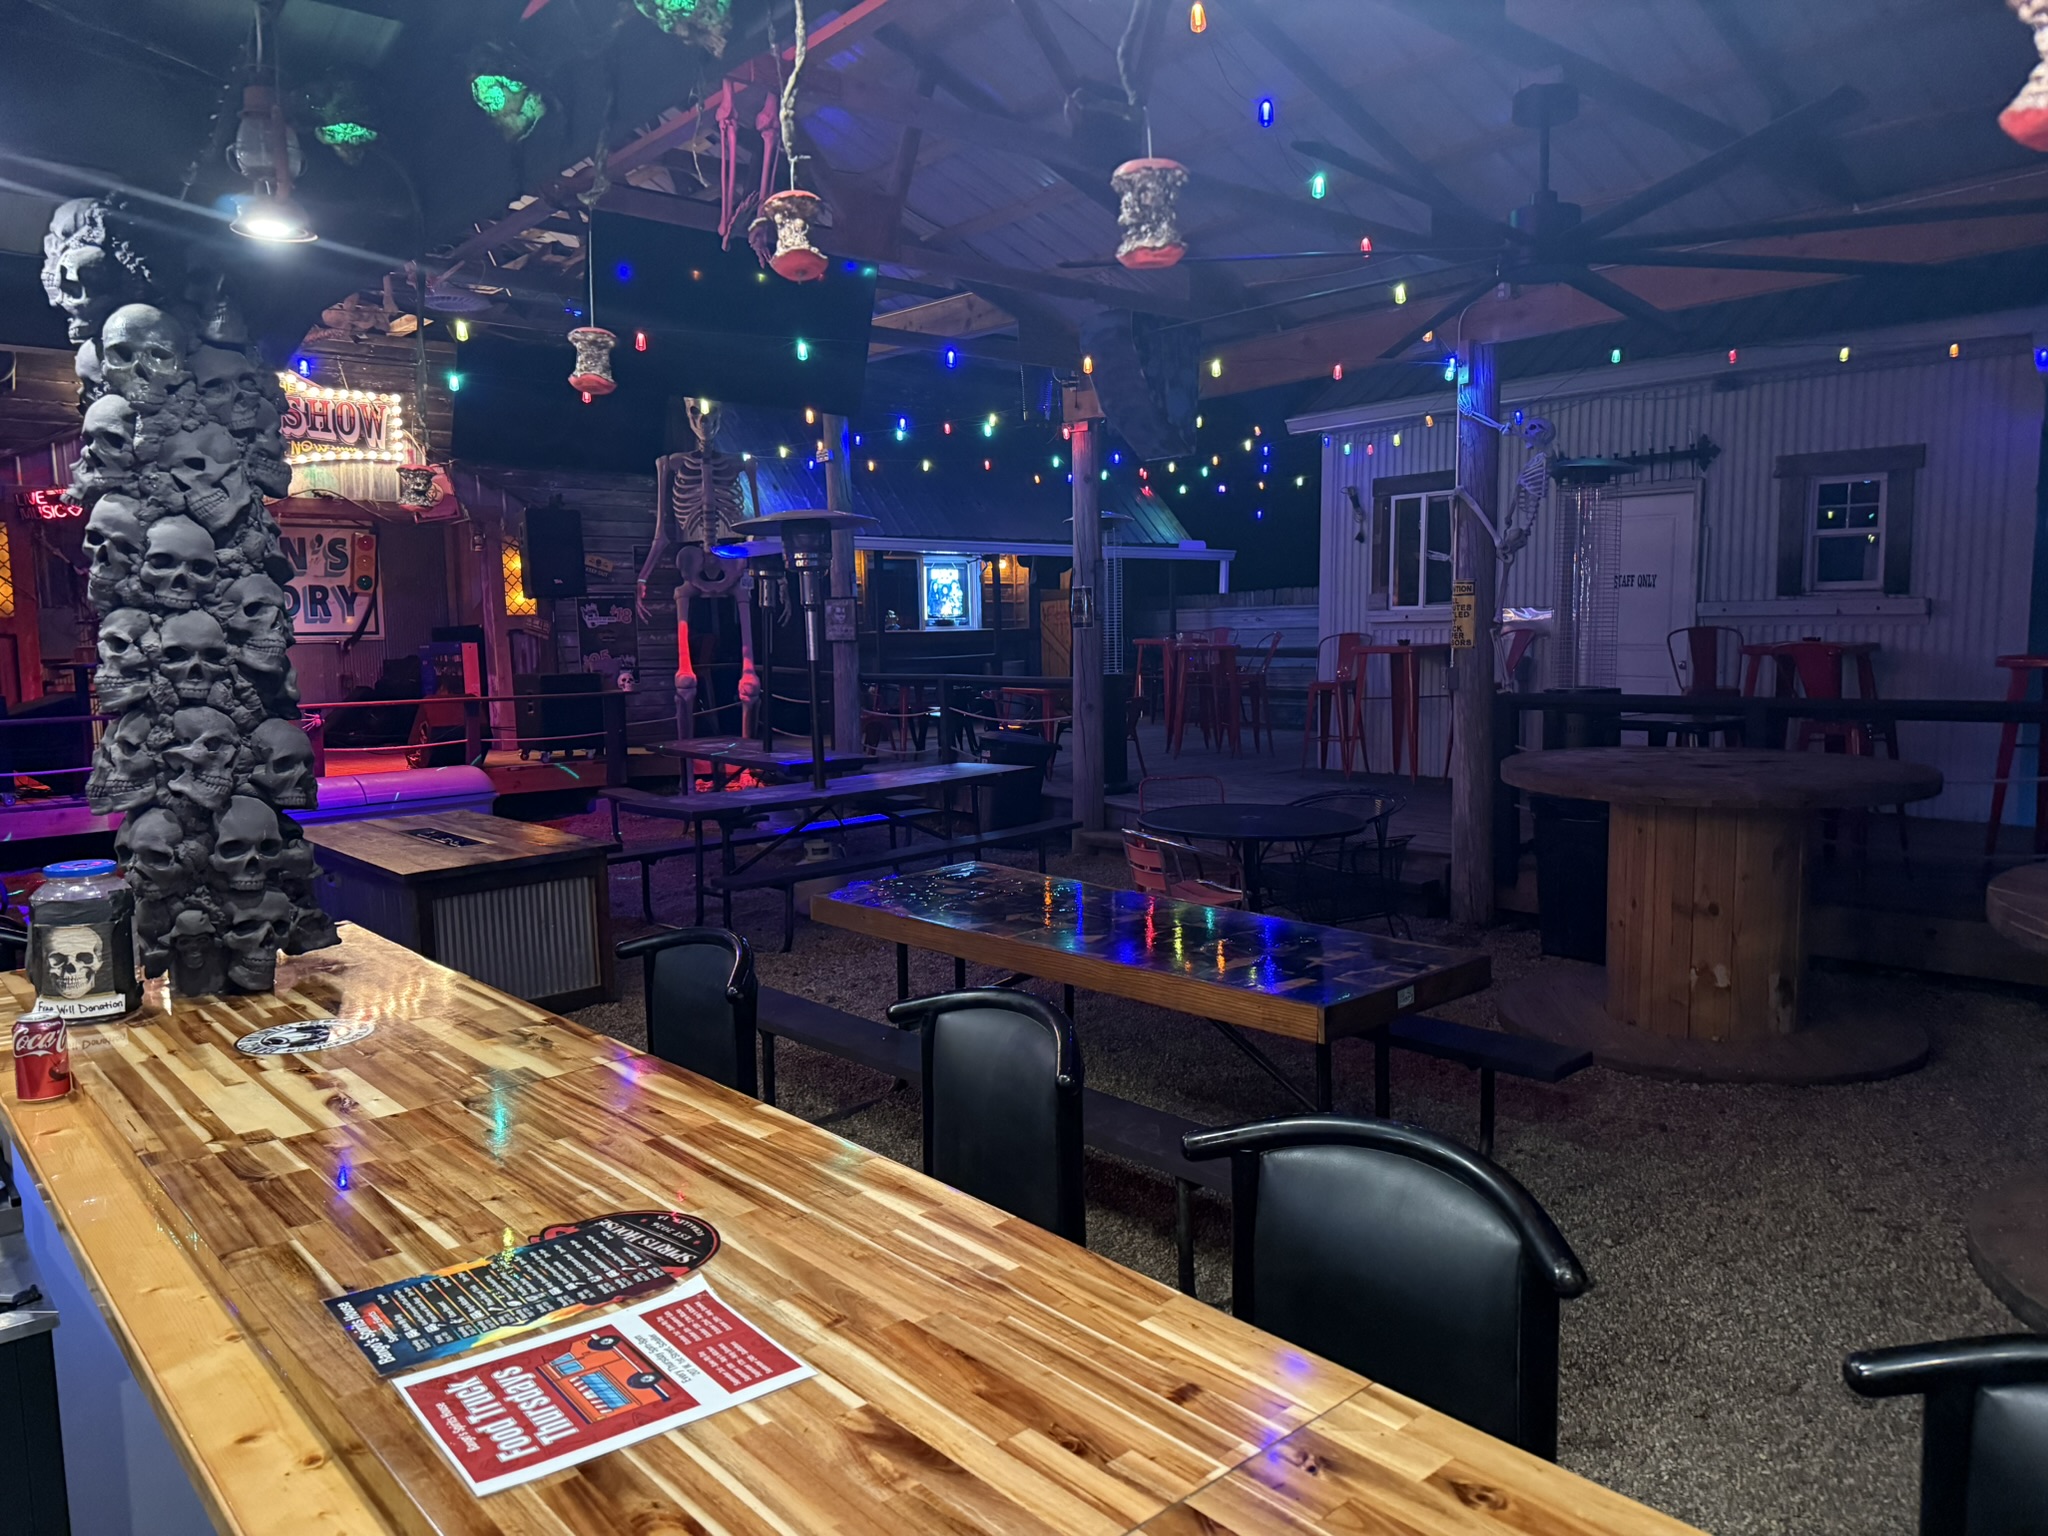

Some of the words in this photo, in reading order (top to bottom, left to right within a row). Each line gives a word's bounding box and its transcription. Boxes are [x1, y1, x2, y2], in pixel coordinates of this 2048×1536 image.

[282, 396, 389, 449] SHOW
[279, 533, 349, 573] N'S
[1614, 574, 1635, 588] STAFF
[1638, 574, 1657, 588] ONLY
[282, 584, 359, 619] ORY
[78, 1000, 124, 1014] Donation
[600, 1218, 646, 1243] HOUSE
[674, 1231, 692, 1241] EST
[638, 1237, 698, 1264] SPIRITS
[337, 1301, 360, 1321] House
[350, 1318, 377, 1340] Spirits
[363, 1337, 396, 1364] Bango's
[654, 1351, 678, 1372] Thursday
[673, 1369, 692, 1384] Every
[435, 1401, 453, 1418] House
[444, 1375, 506, 1424] Truck
[490, 1365, 579, 1446] Thursdays
[474, 1416, 539, 1462] Food
